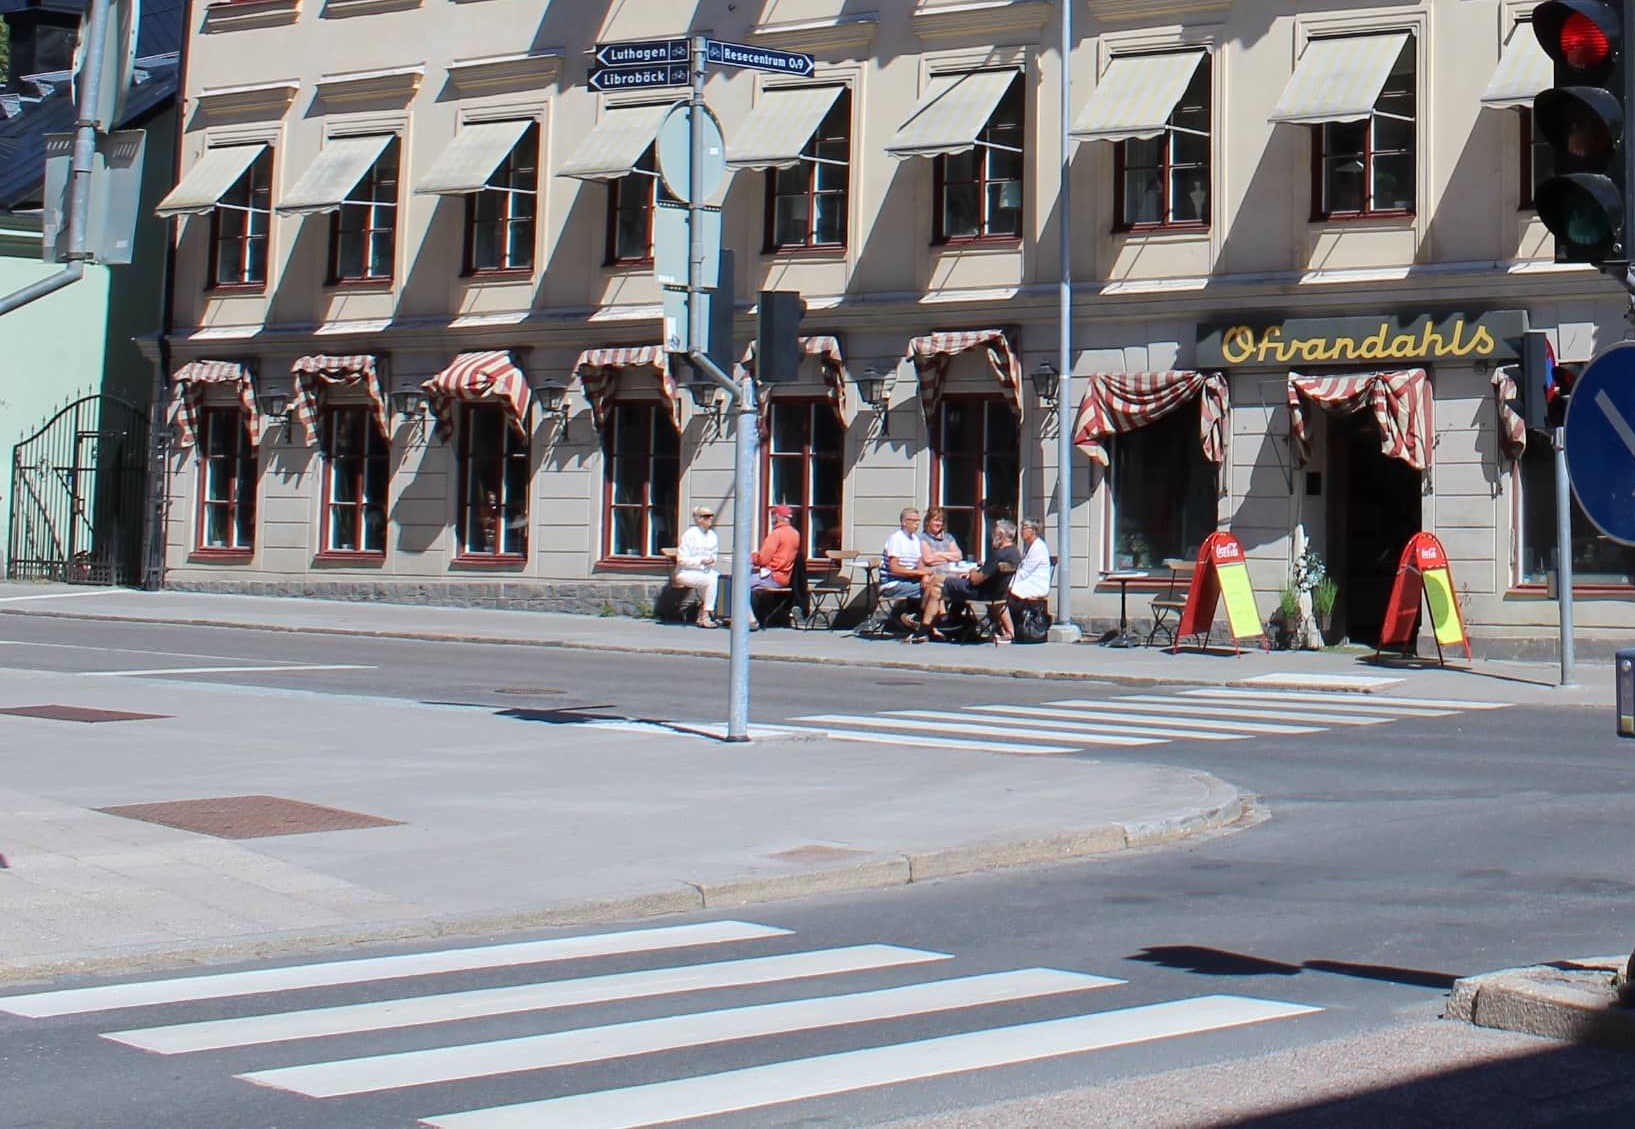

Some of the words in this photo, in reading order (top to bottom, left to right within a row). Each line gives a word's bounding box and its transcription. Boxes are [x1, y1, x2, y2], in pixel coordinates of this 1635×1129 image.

[611, 48, 666, 61] Luthagen
[724, 48, 786, 67] Resecentrum
[788, 57, 804, 69] 0,9
[604, 71, 665, 85] Libroböck
[1222, 319, 1495, 364] Ofvandahls
